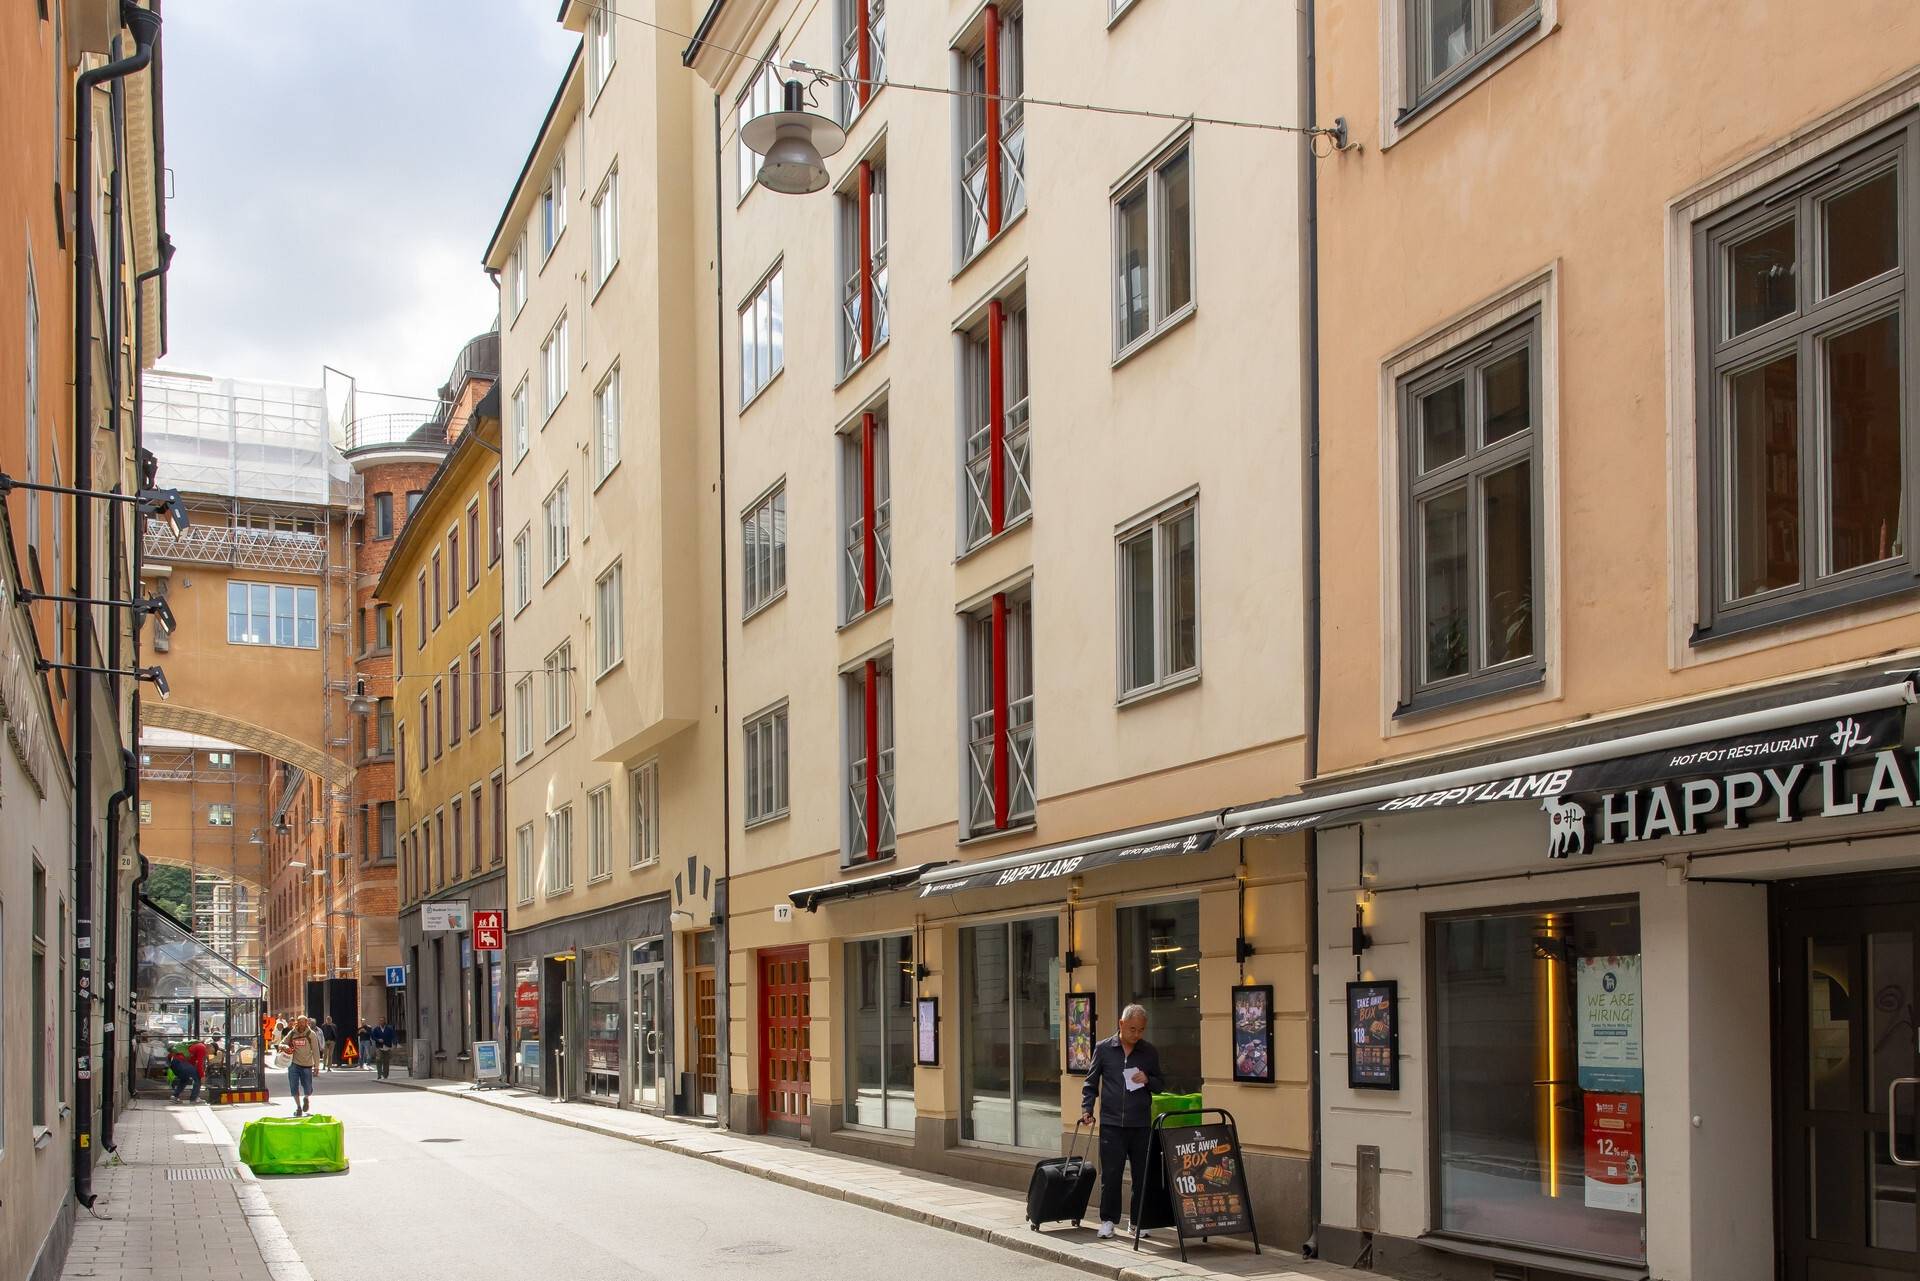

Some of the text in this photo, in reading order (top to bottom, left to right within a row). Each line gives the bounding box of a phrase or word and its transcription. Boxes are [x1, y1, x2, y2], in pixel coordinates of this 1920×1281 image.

[1669, 734, 1819, 767] HOT POT RESTAURANT
[1378, 768, 1573, 811] HAPPY LAMB
[1601, 746, 1920, 845] HAPPY LA
[121, 858, 131, 866] 20
[994, 861, 1044, 886] HAPPY
[1038, 856, 1084, 879] LAMB
[779, 908, 788, 918] 17
[1356, 996, 1370, 1009] TAKE
[1587, 993, 1635, 1007] WE ARE
[1359, 1007, 1377, 1021] BOX
[1589, 1008, 1633, 1023] HIRING!
[1354, 1027, 1365, 1044] 118
[1175, 1142, 1196, 1156] TAKE
[1198, 1139, 1218, 1152] AWAY
[1183, 1151, 1209, 1170] BOX
[1176, 1175, 1205, 1194] 118 KR
